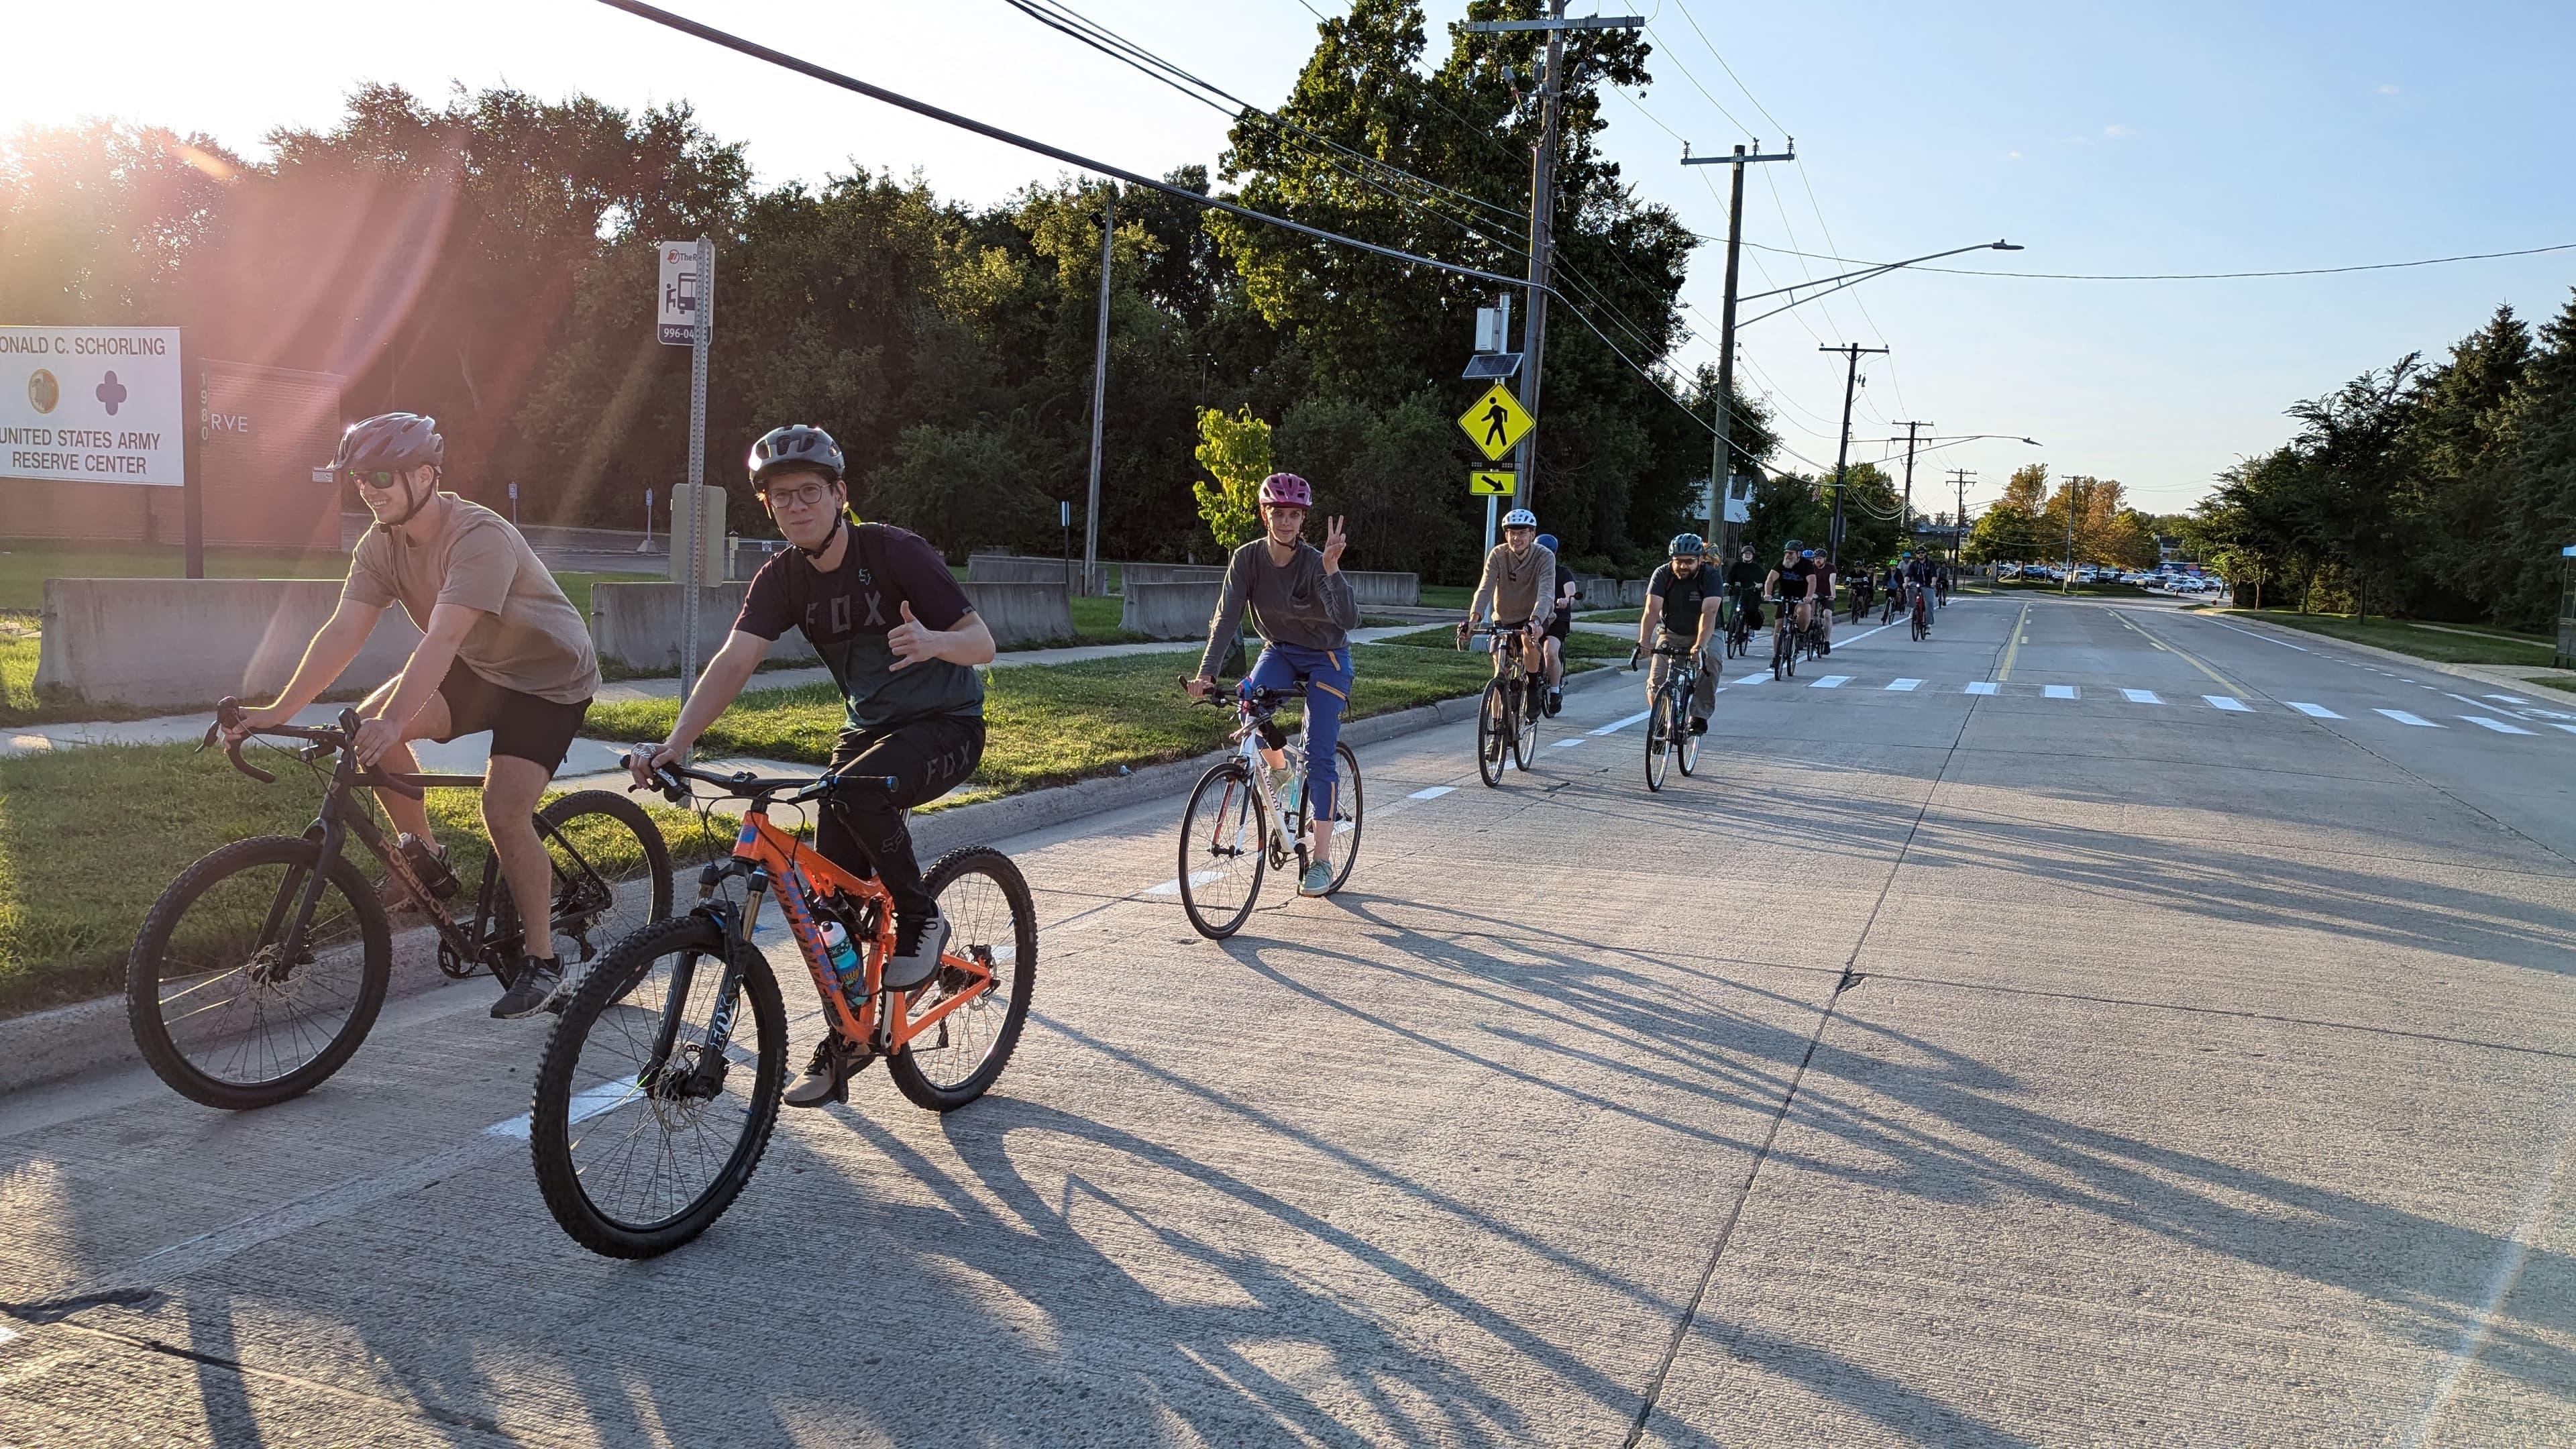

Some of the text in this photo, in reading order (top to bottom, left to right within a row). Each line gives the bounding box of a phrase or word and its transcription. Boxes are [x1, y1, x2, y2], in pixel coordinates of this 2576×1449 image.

[680, 253, 698, 262] TheR
[663, 327, 694, 339] 996-04
[0, 336, 166, 356] ONALD C. SCHORLING
[211, 413, 248, 433] RVE
[0, 427, 161, 451] UNITED STATES ARMY
[12, 451, 147, 474] RESERVE CENTER
[806, 590, 887, 637] FOX
[926, 739, 970, 786] FOX
[377, 839, 453, 926] POSEIDON
[708, 993, 739, 1051] FOX
